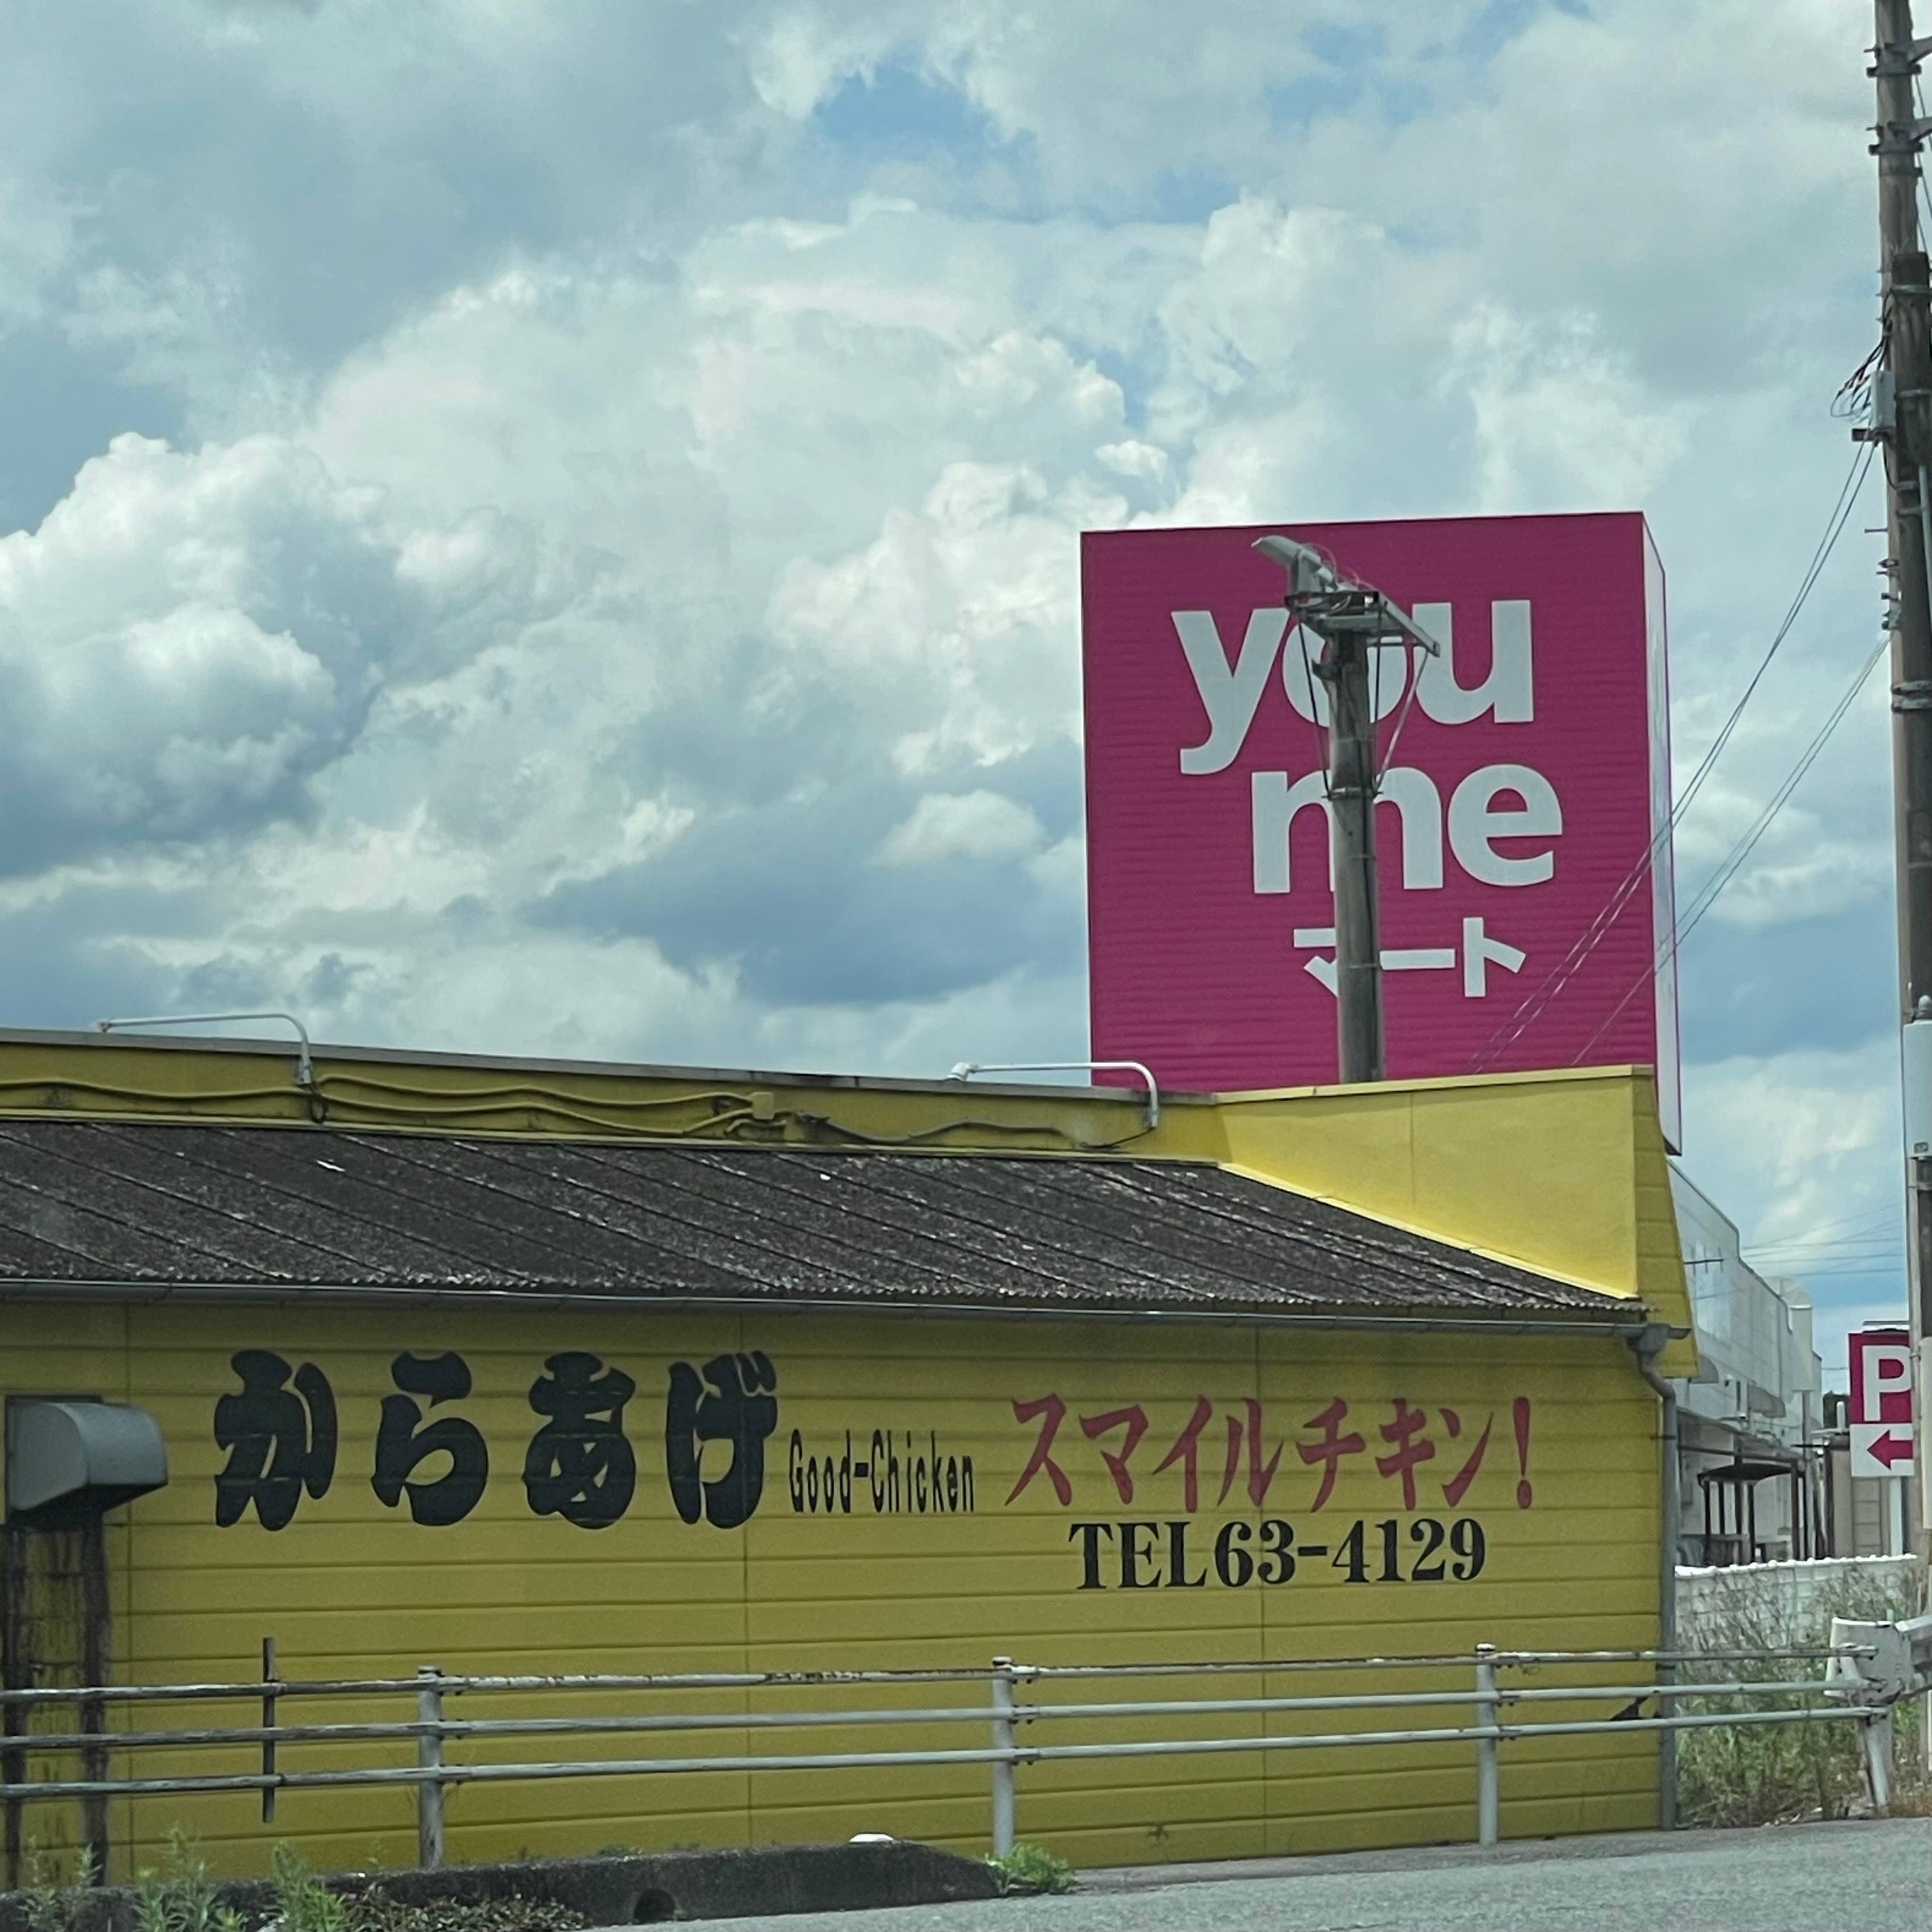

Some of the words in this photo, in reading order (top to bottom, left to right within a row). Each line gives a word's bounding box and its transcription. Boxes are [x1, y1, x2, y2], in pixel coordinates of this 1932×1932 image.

[1171, 599, 1534, 774] you
[1251, 763, 1563, 894] me
[214, 1349, 778, 1531] からあげ
[1862, 1345, 1912, 1422] P
[789, 1429, 974, 1513] Good-Chicken
